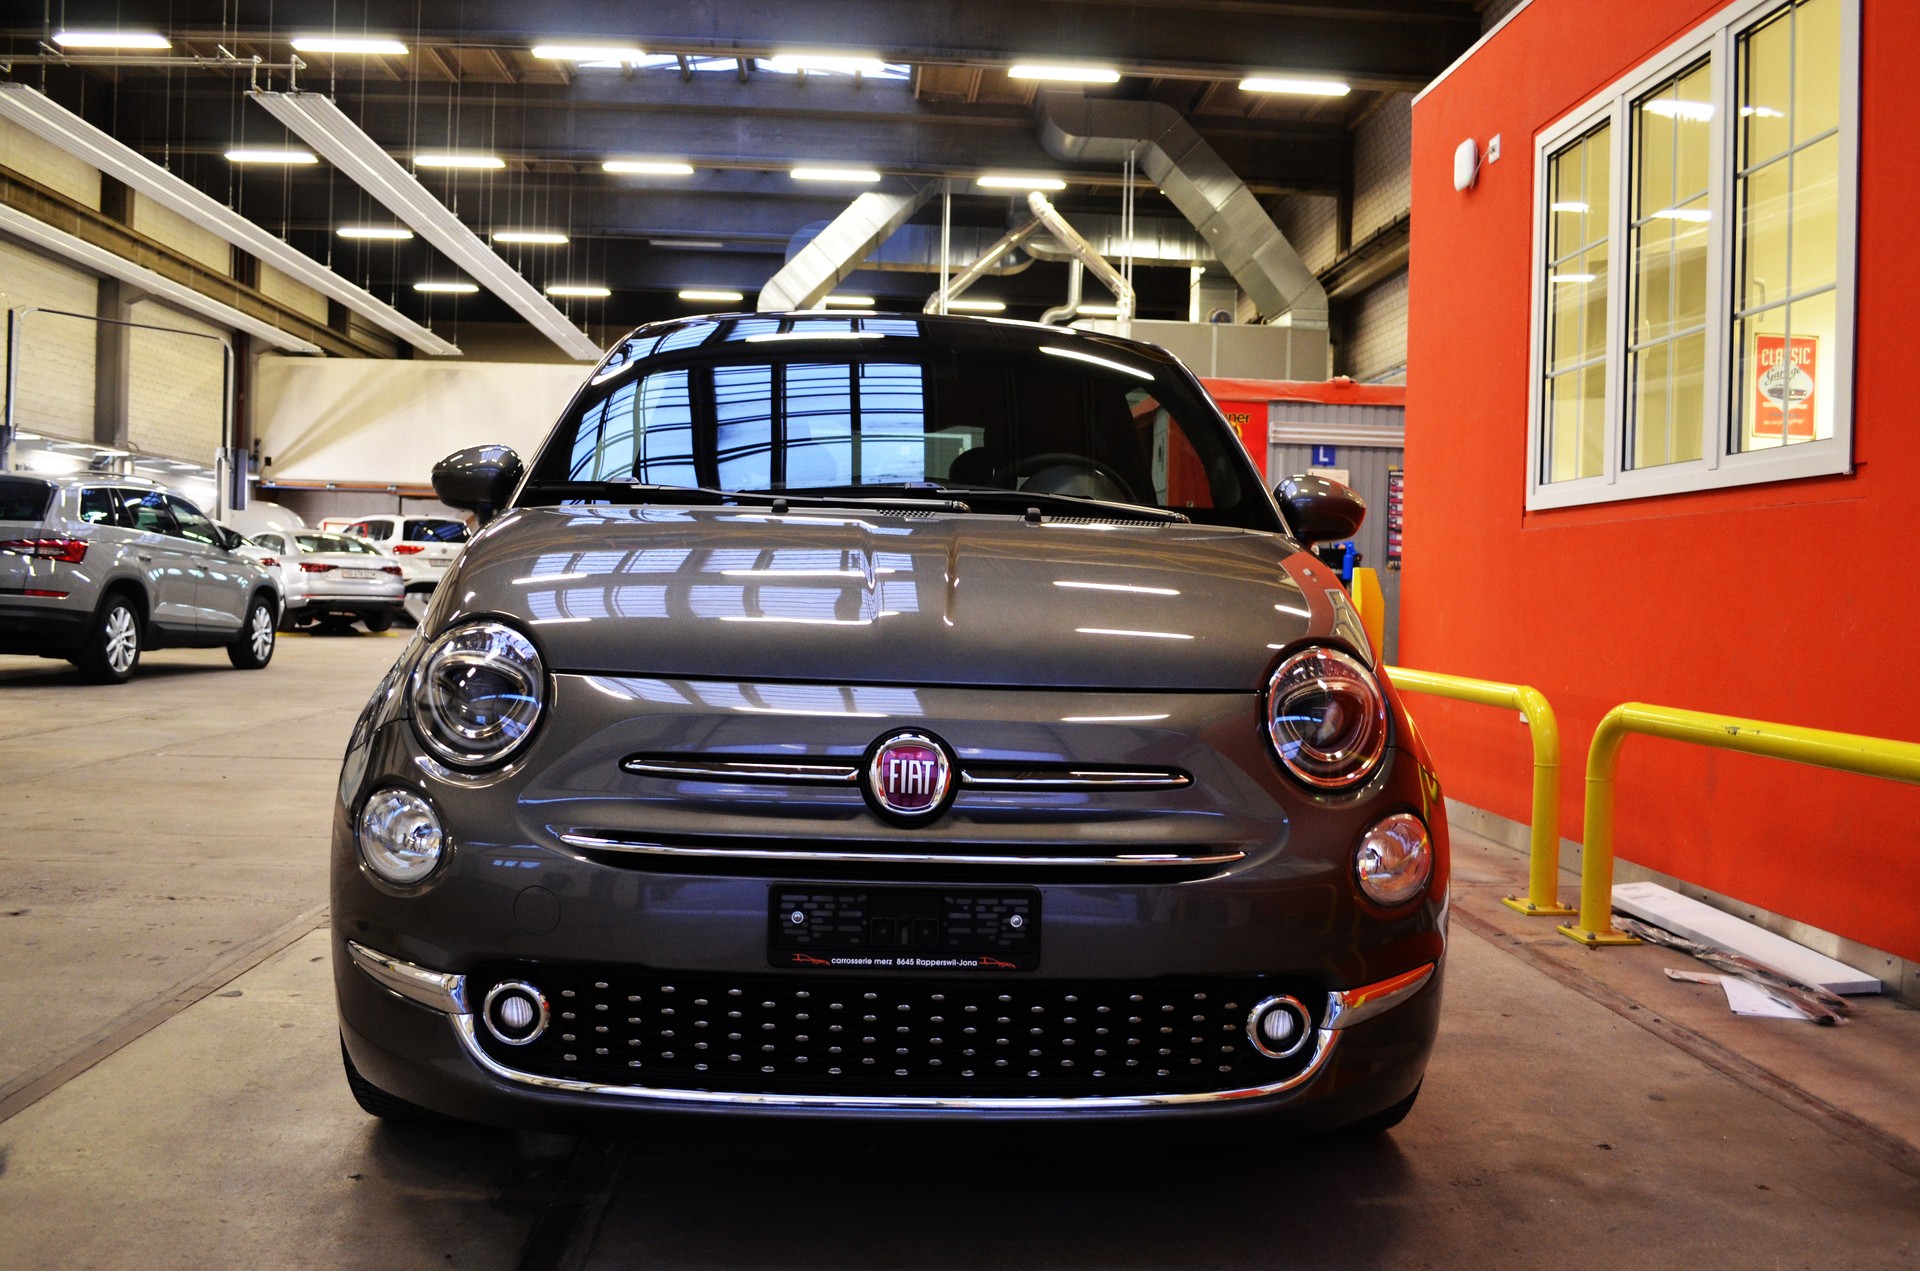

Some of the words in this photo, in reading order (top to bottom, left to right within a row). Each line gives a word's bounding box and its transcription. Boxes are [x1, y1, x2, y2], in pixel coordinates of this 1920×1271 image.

[1761, 347, 1811, 366] CLASIC
[1764, 367, 1800, 386] Garge
[1319, 446, 1329, 462] L
[889, 759, 935, 795] FIAT
[831, 957, 873, 965] carrosserie
[873, 958, 893, 966] merz
[896, 958, 914, 966] 8645
[915, 958, 978, 967] Rapperswil-Jona
